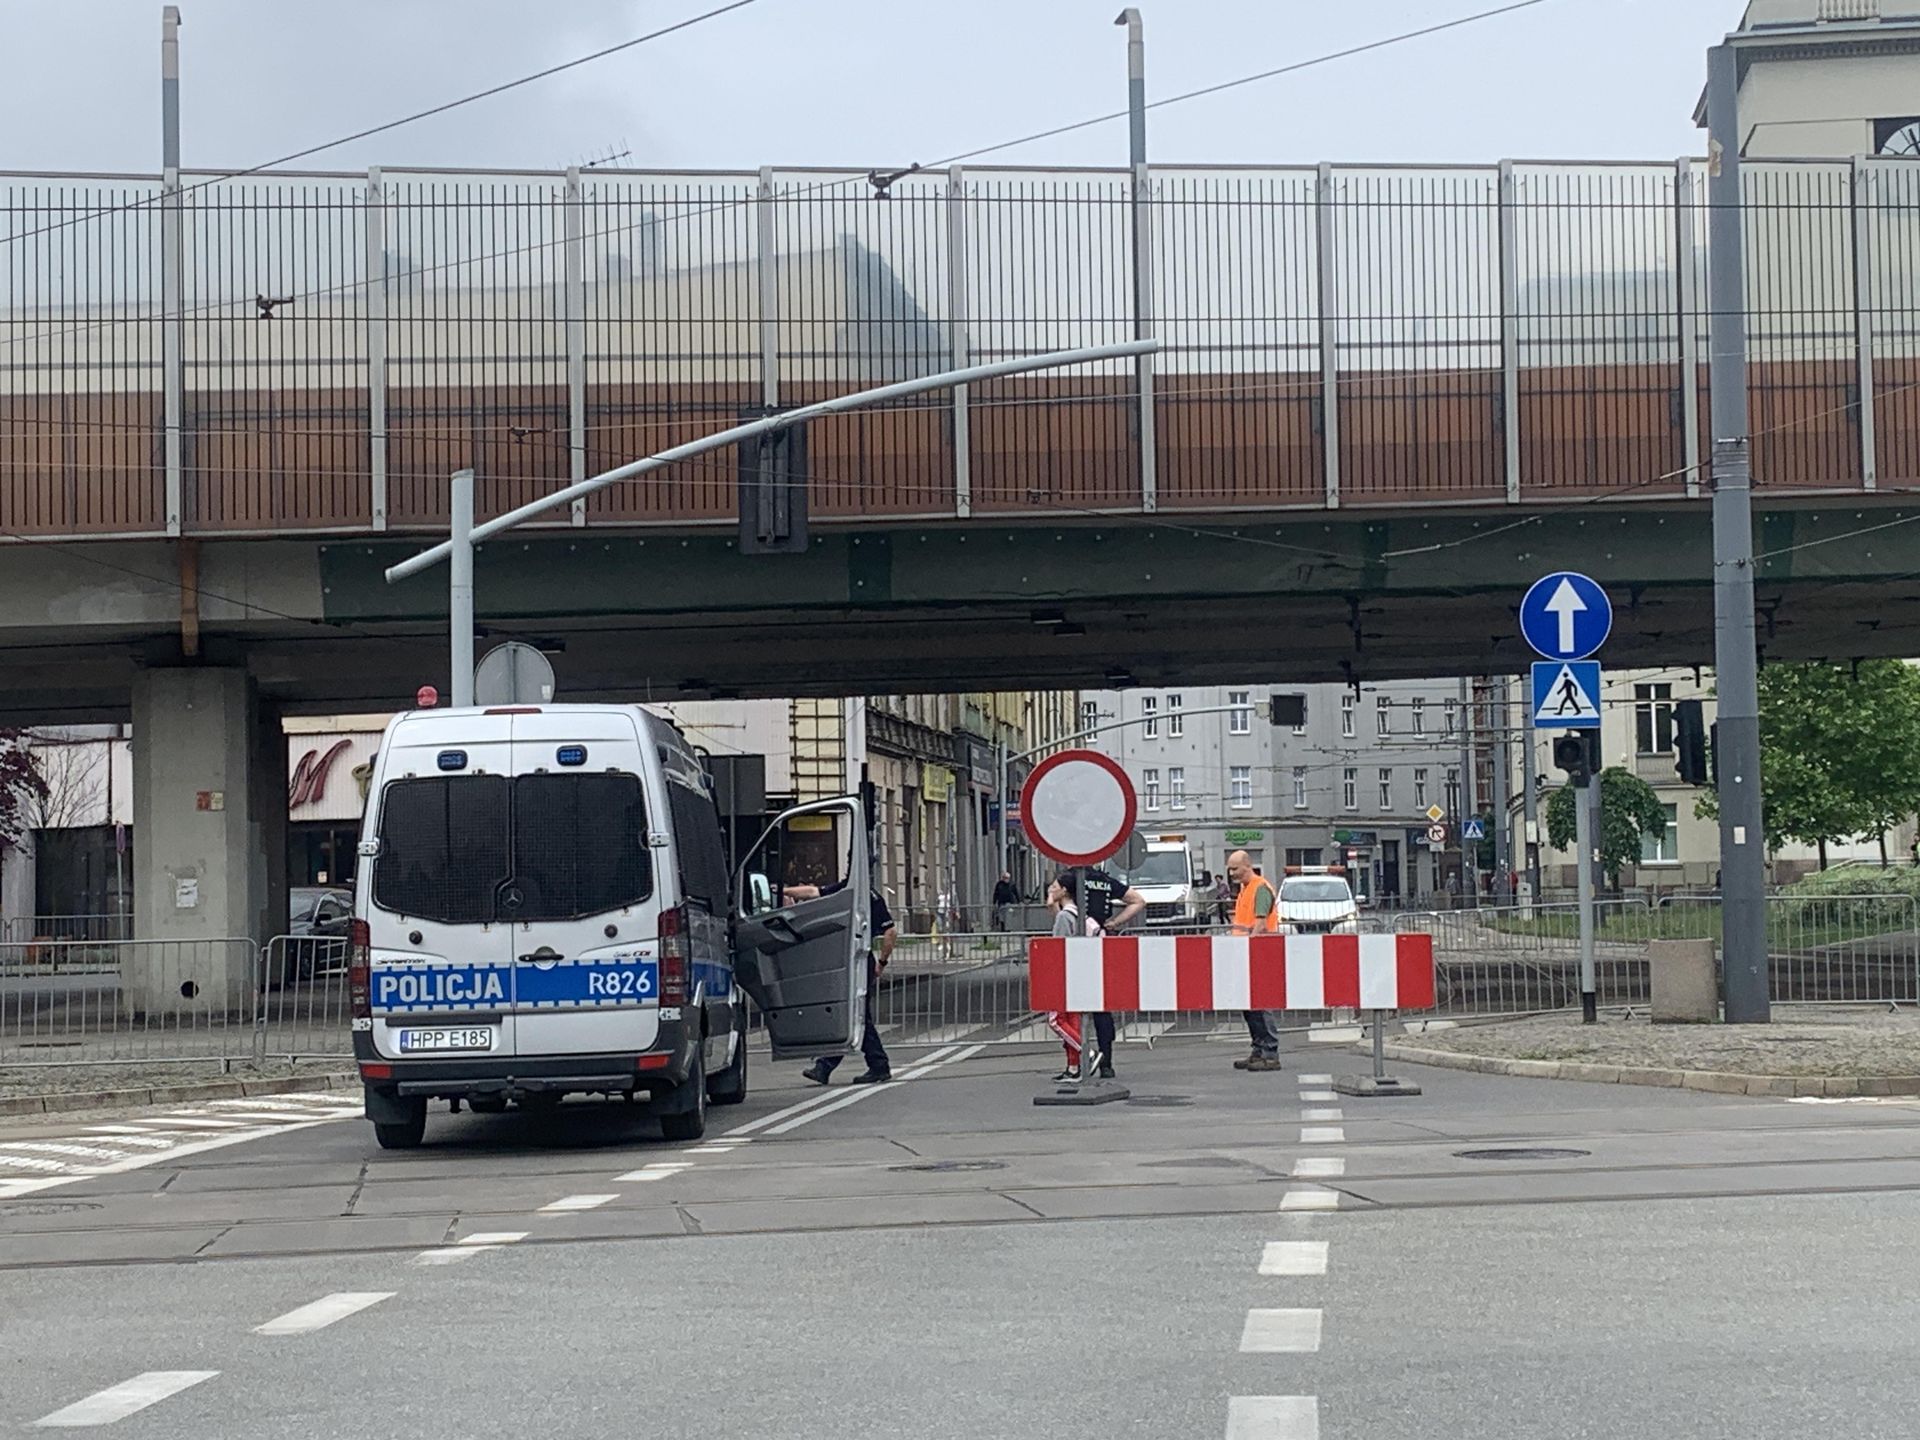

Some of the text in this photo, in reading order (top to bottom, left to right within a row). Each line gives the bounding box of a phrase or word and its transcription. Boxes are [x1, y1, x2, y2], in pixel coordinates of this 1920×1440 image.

[380, 972, 503, 1003] POLICJA
[589, 970, 651, 995] R826
[411, 1030, 488, 1048] HPP E185
